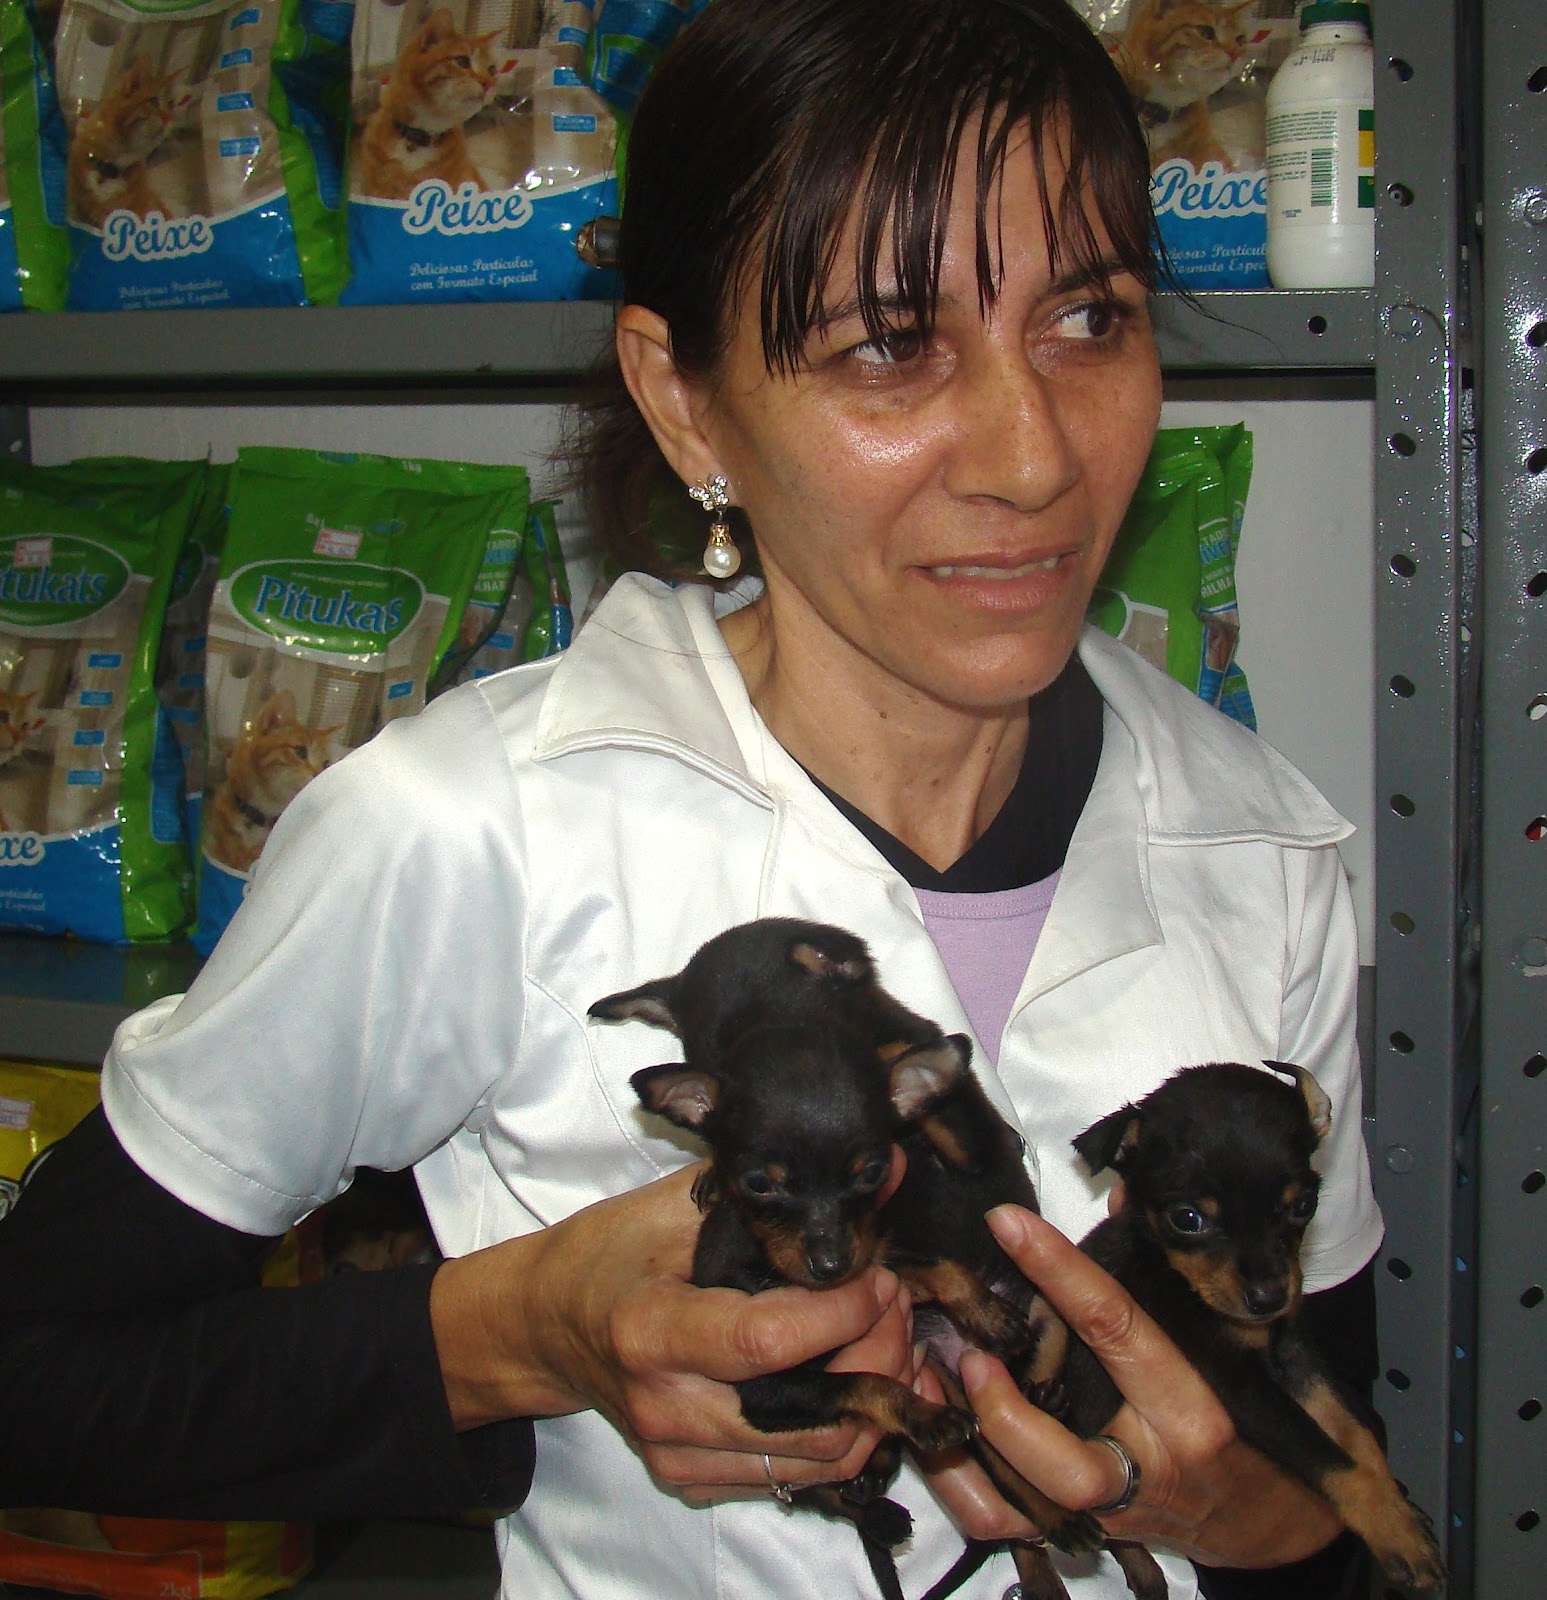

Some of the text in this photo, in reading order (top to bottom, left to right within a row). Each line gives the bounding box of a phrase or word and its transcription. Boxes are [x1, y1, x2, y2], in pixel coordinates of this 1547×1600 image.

[408, 184, 526, 229] Peixe
[1153, 165, 1267, 211] Peixe
[106, 215, 209, 255] Peixe
[1211, 242, 1267, 258] Particul
[488, 270, 539, 288] Especial
[1229, 258, 1267, 275] Espec
[0, 565, 109, 603] tukats
